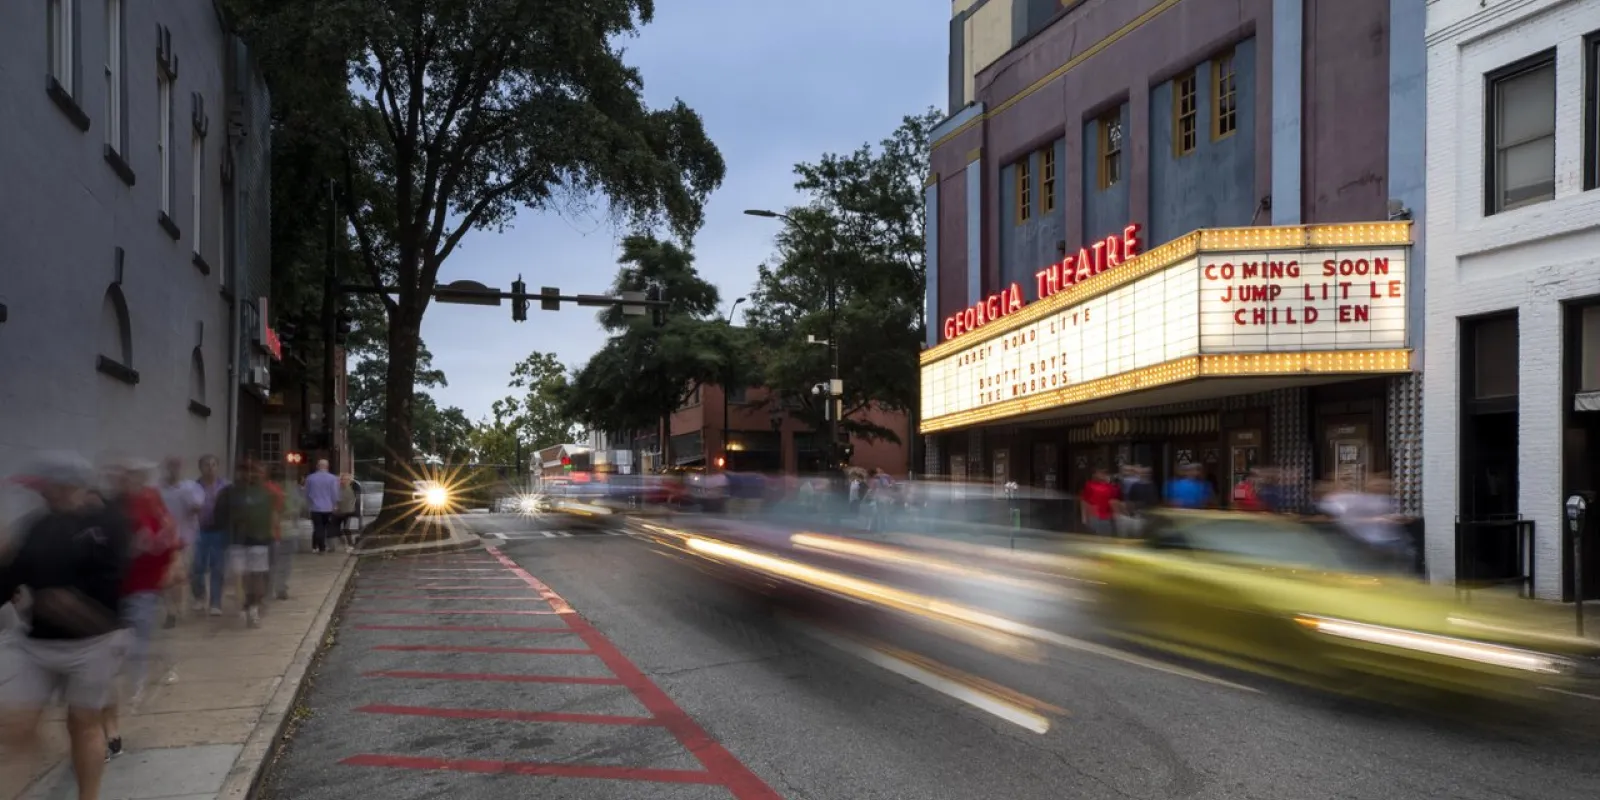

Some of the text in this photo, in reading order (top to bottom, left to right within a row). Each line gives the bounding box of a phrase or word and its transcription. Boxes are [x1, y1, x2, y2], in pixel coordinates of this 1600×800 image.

[944, 224, 1139, 340] GEORGIA THEATRE
[1204, 257, 1389, 281] COMING SOON
[1220, 284, 1282, 302] JUMP
[958, 308, 1090, 368] ABBEY ROAD LIVE
[979, 352, 1067, 390] BOOTY BOYZ
[979, 389, 1001, 405] THE
